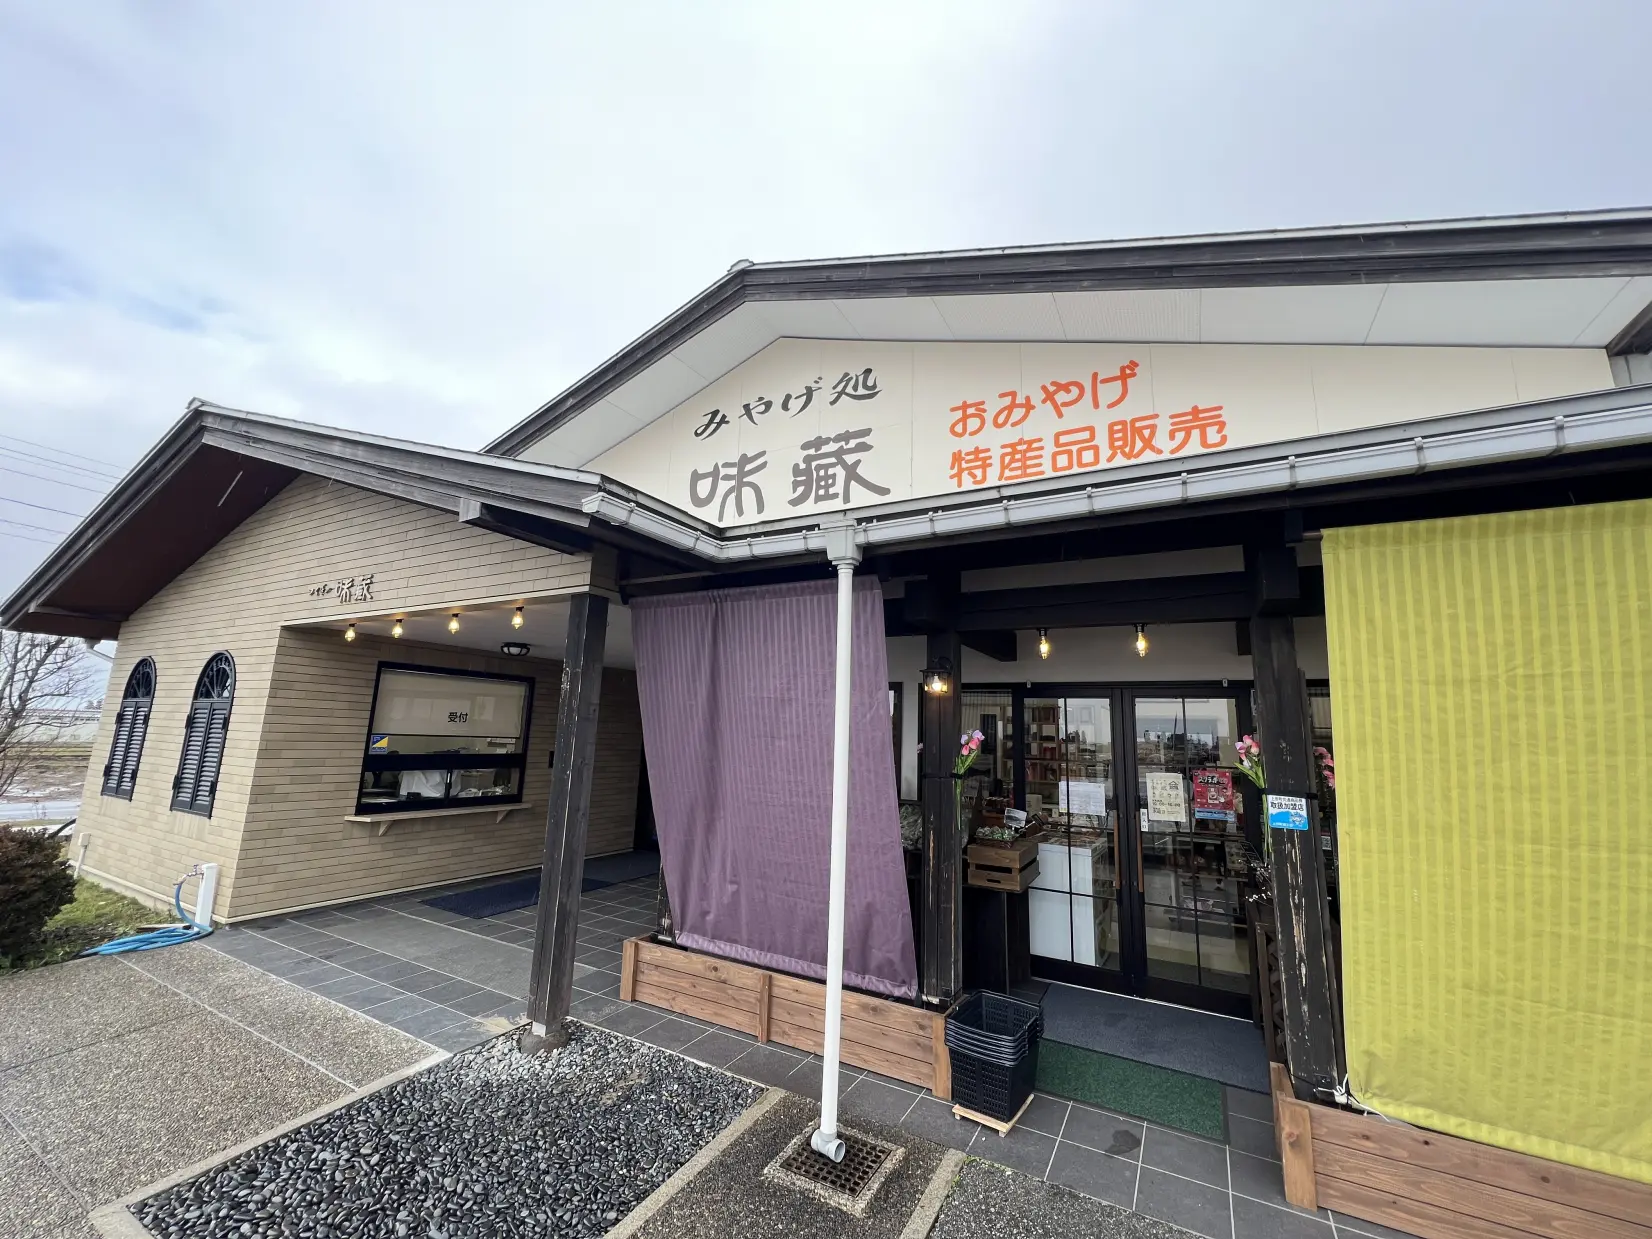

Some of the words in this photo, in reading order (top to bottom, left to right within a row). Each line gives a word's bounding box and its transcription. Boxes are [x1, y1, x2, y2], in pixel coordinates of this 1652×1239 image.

[693, 367, 883, 441] みやげ処
[949, 359, 1140, 438] おみやげ
[949, 405, 1228, 488] 特産品販売
[447, 711, 468, 723] 受付
[1270, 801, 1304, 811] 取扱加盟店
